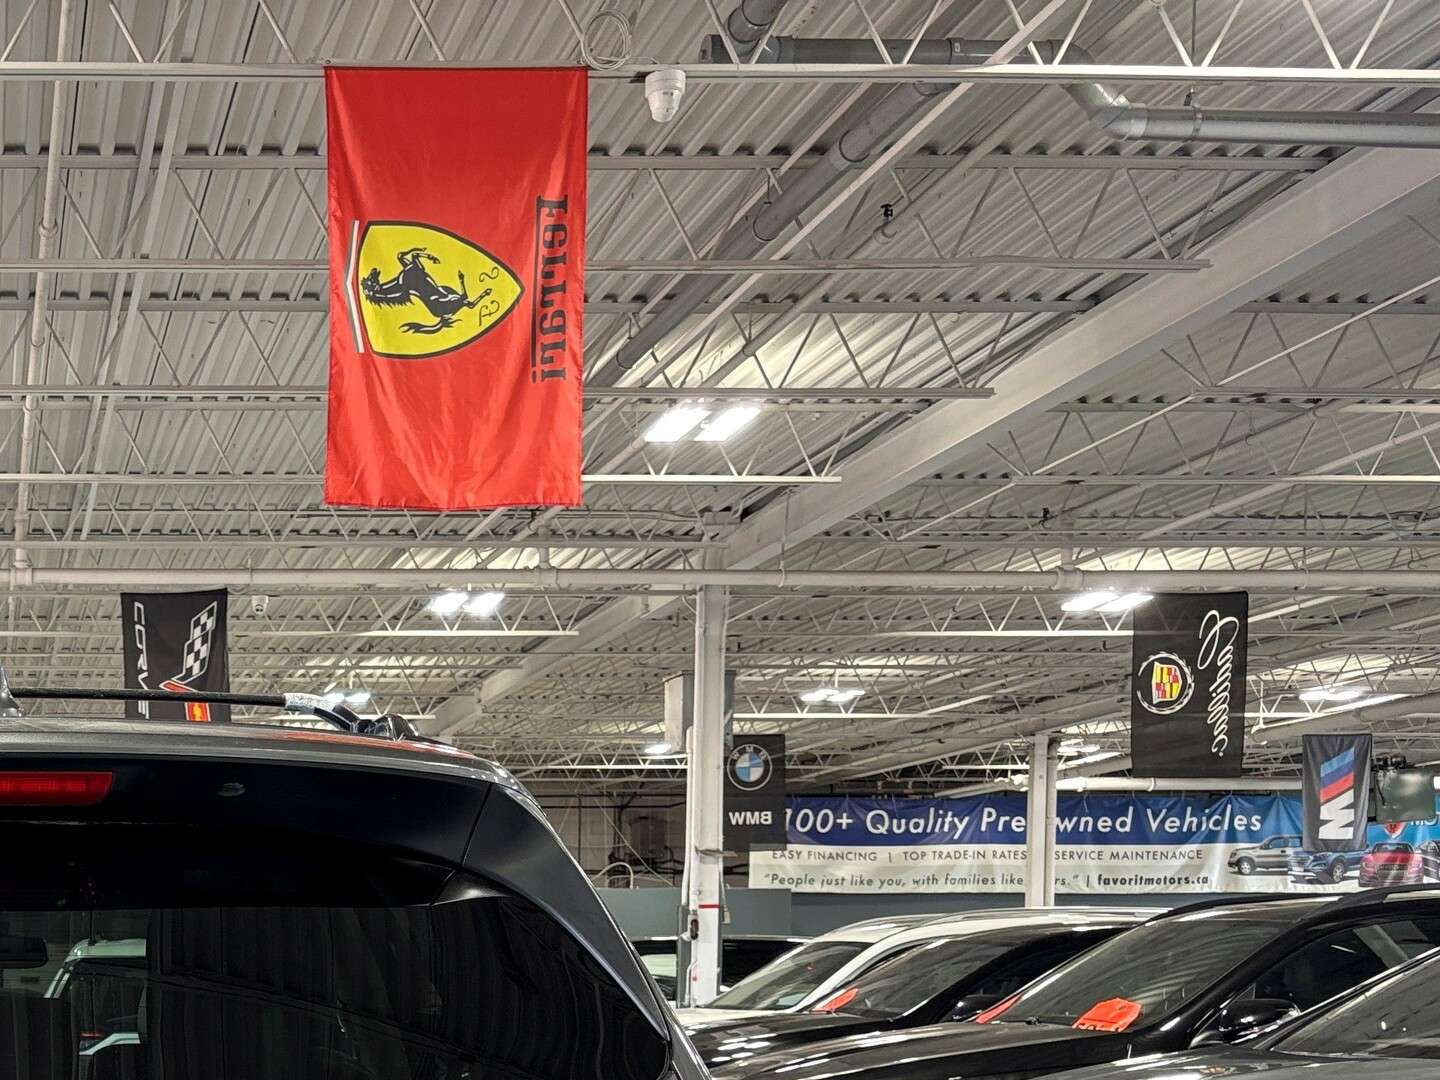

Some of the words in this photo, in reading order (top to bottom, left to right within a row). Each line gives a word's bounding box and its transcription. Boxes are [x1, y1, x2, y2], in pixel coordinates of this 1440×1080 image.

[865, 807, 970, 840] Quality
[1146, 803, 1262, 833] Vehicles
[771, 849, 803, 860] EASY
[807, 850, 878, 861] FINANCING
[903, 850, 927, 861] TOP
[932, 850, 986, 860] TRADE-IN
[992, 850, 1028, 860] RATES
[1054, 850, 1104, 861] SERVICE
[1110, 849, 1204, 861] MAINTENANCE
[820, 875, 846, 888] just
[850, 874, 874, 886] like
[878, 877, 907, 889] you,
[912, 873, 939, 886] with
[944, 872, 996, 886] families
[1001, 872, 1025, 886] like
[1097, 873, 1209, 886] favoritmotors.ca
